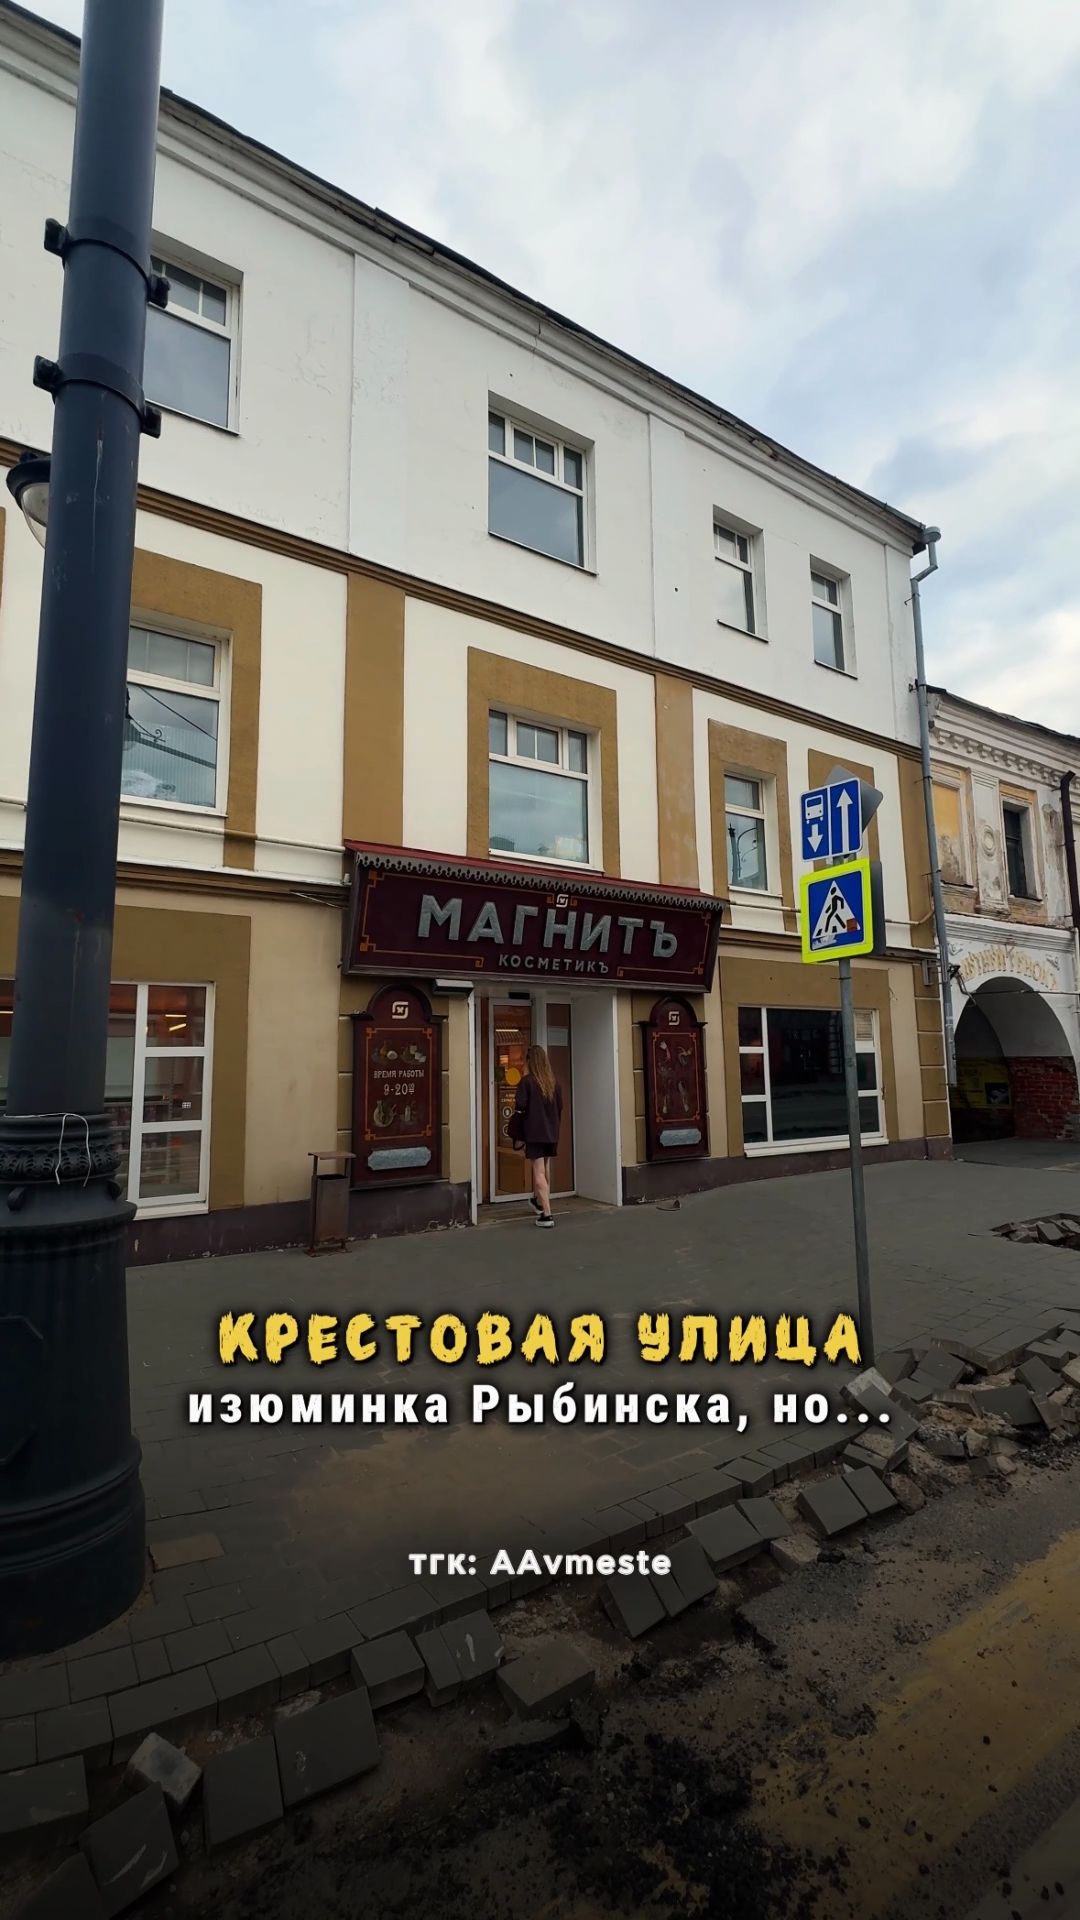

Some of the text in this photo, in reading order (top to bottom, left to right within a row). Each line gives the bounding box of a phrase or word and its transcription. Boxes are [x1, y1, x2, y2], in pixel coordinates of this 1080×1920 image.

[417, 894, 679, 959] МАГНИТЪ
[498, 953, 610, 975] КОСМЕТИКЪ
[373, 1069, 425, 1079] ВРЕМЯ РАБОТЫ
